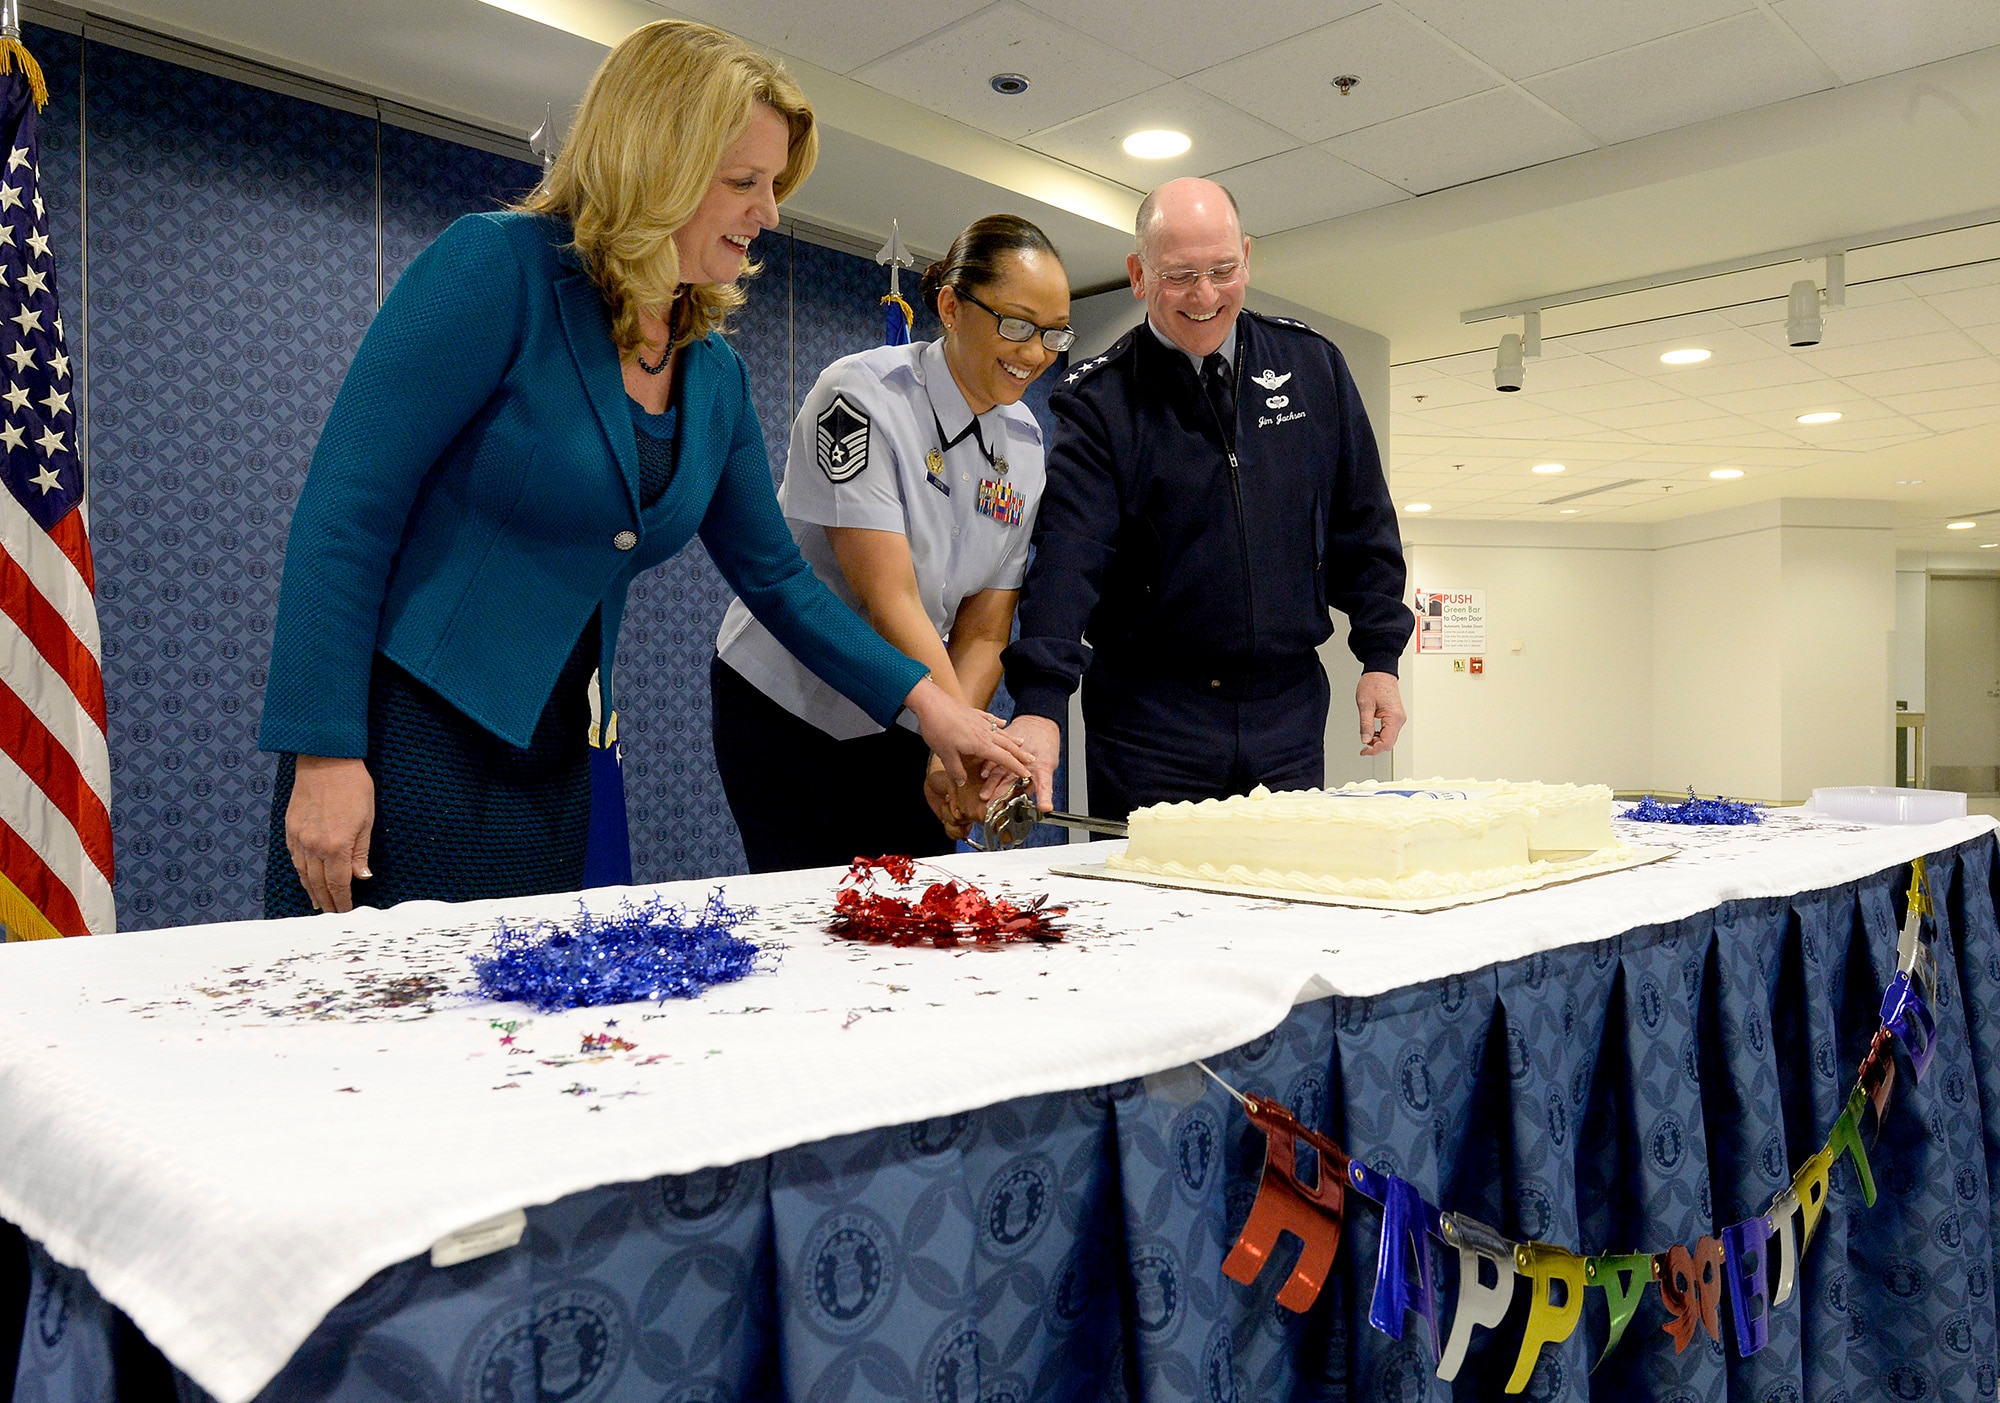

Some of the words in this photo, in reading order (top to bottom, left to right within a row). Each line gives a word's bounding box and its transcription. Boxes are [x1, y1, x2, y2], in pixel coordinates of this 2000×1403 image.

[1258, 416, 1273, 428] Jim
[1276, 411, 1306, 425] Jackson
[1444, 594, 1472, 604] PUSH
[1451, 615, 1467, 623] Open
[1222, 1092, 1654, 1394] HAPPY
